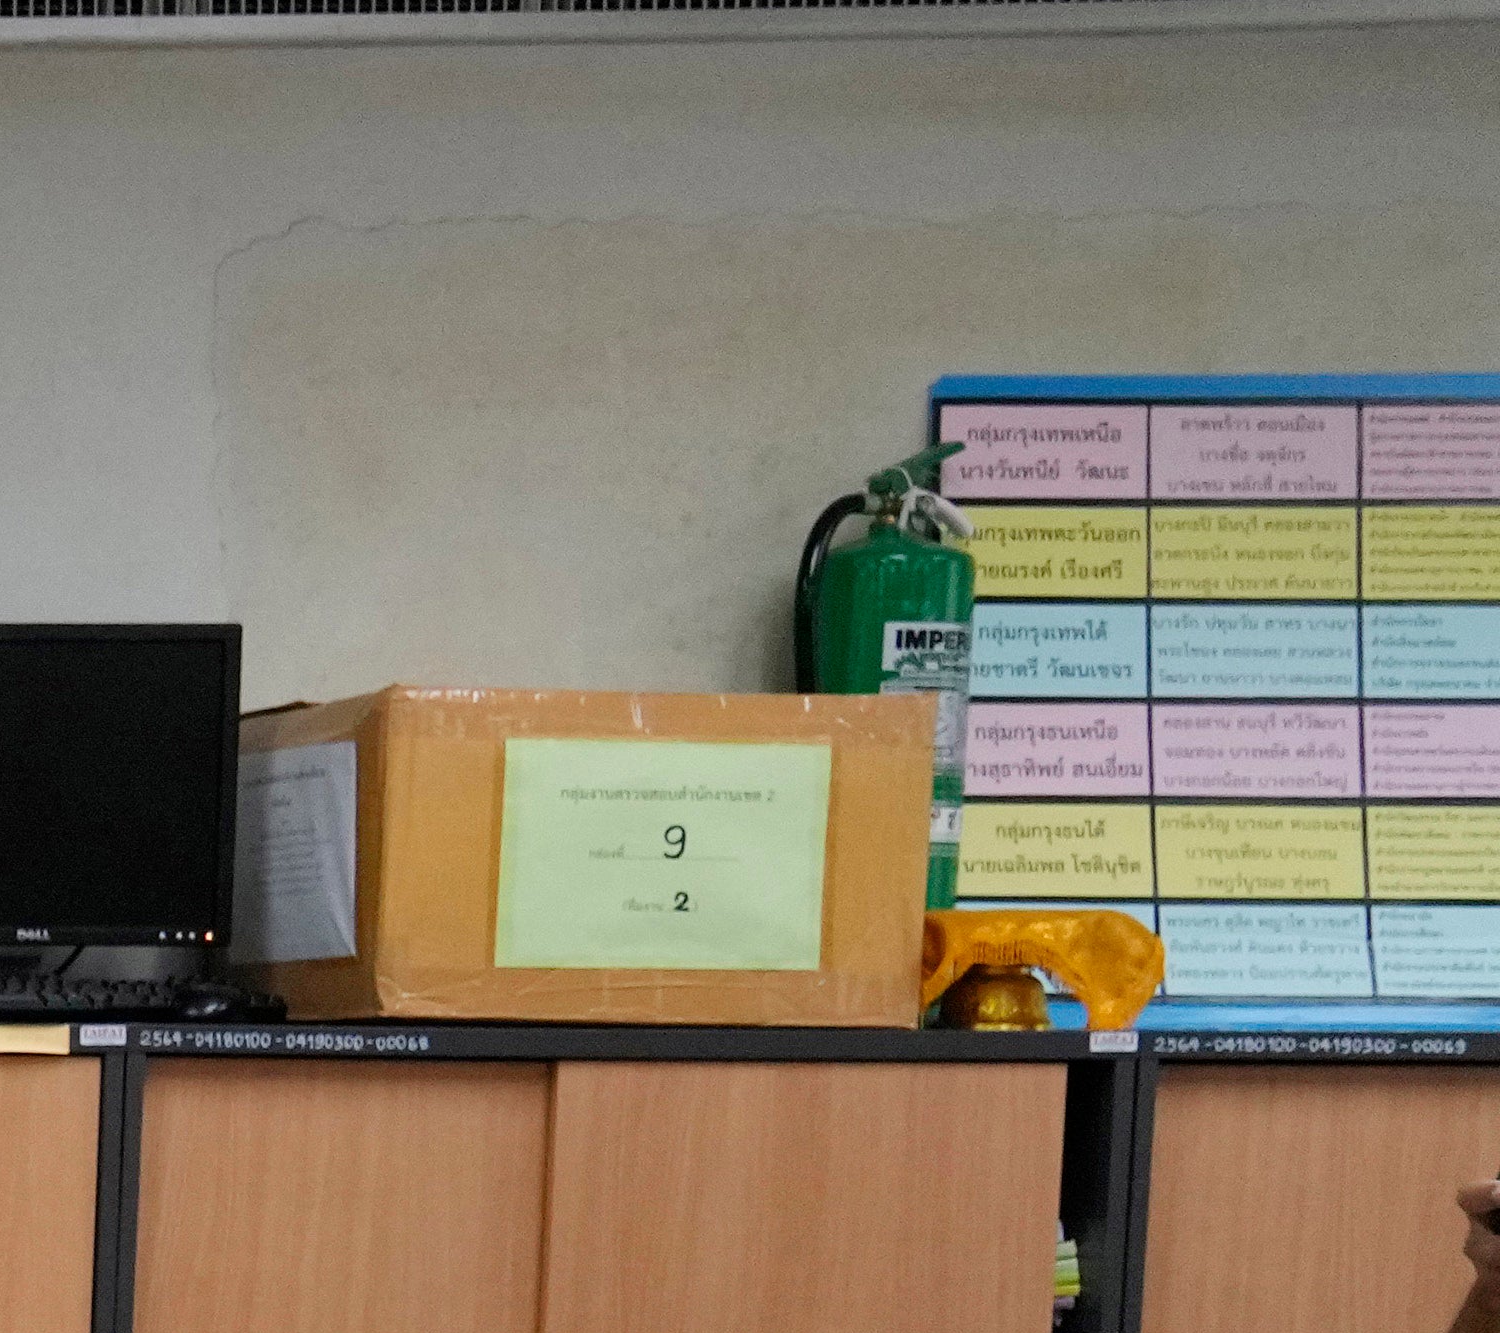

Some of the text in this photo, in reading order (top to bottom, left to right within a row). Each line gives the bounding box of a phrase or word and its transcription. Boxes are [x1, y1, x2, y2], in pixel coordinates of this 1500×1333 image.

[967, 422, 1122, 447] กลุ่มกรุงเทพเหนือ
[960, 458, 1060, 480] นางวันทนีย์
[976, 558, 1124, 579] ายณรงค์ เรืองศรี
[978, 619, 1108, 644] กลุ่มกรุงเทพใต้
[969, 660, 1040, 679] ายชาตรี
[975, 717, 1119, 745] กลุ่มกรุงธนเหนือ
[966, 759, 1064, 788] างสุธาทิพย์
[663, 825, 687, 860] 9
[995, 819, 1105, 845] กลุ่มกรุงธนใต้
[673, 891, 691, 912] 2
